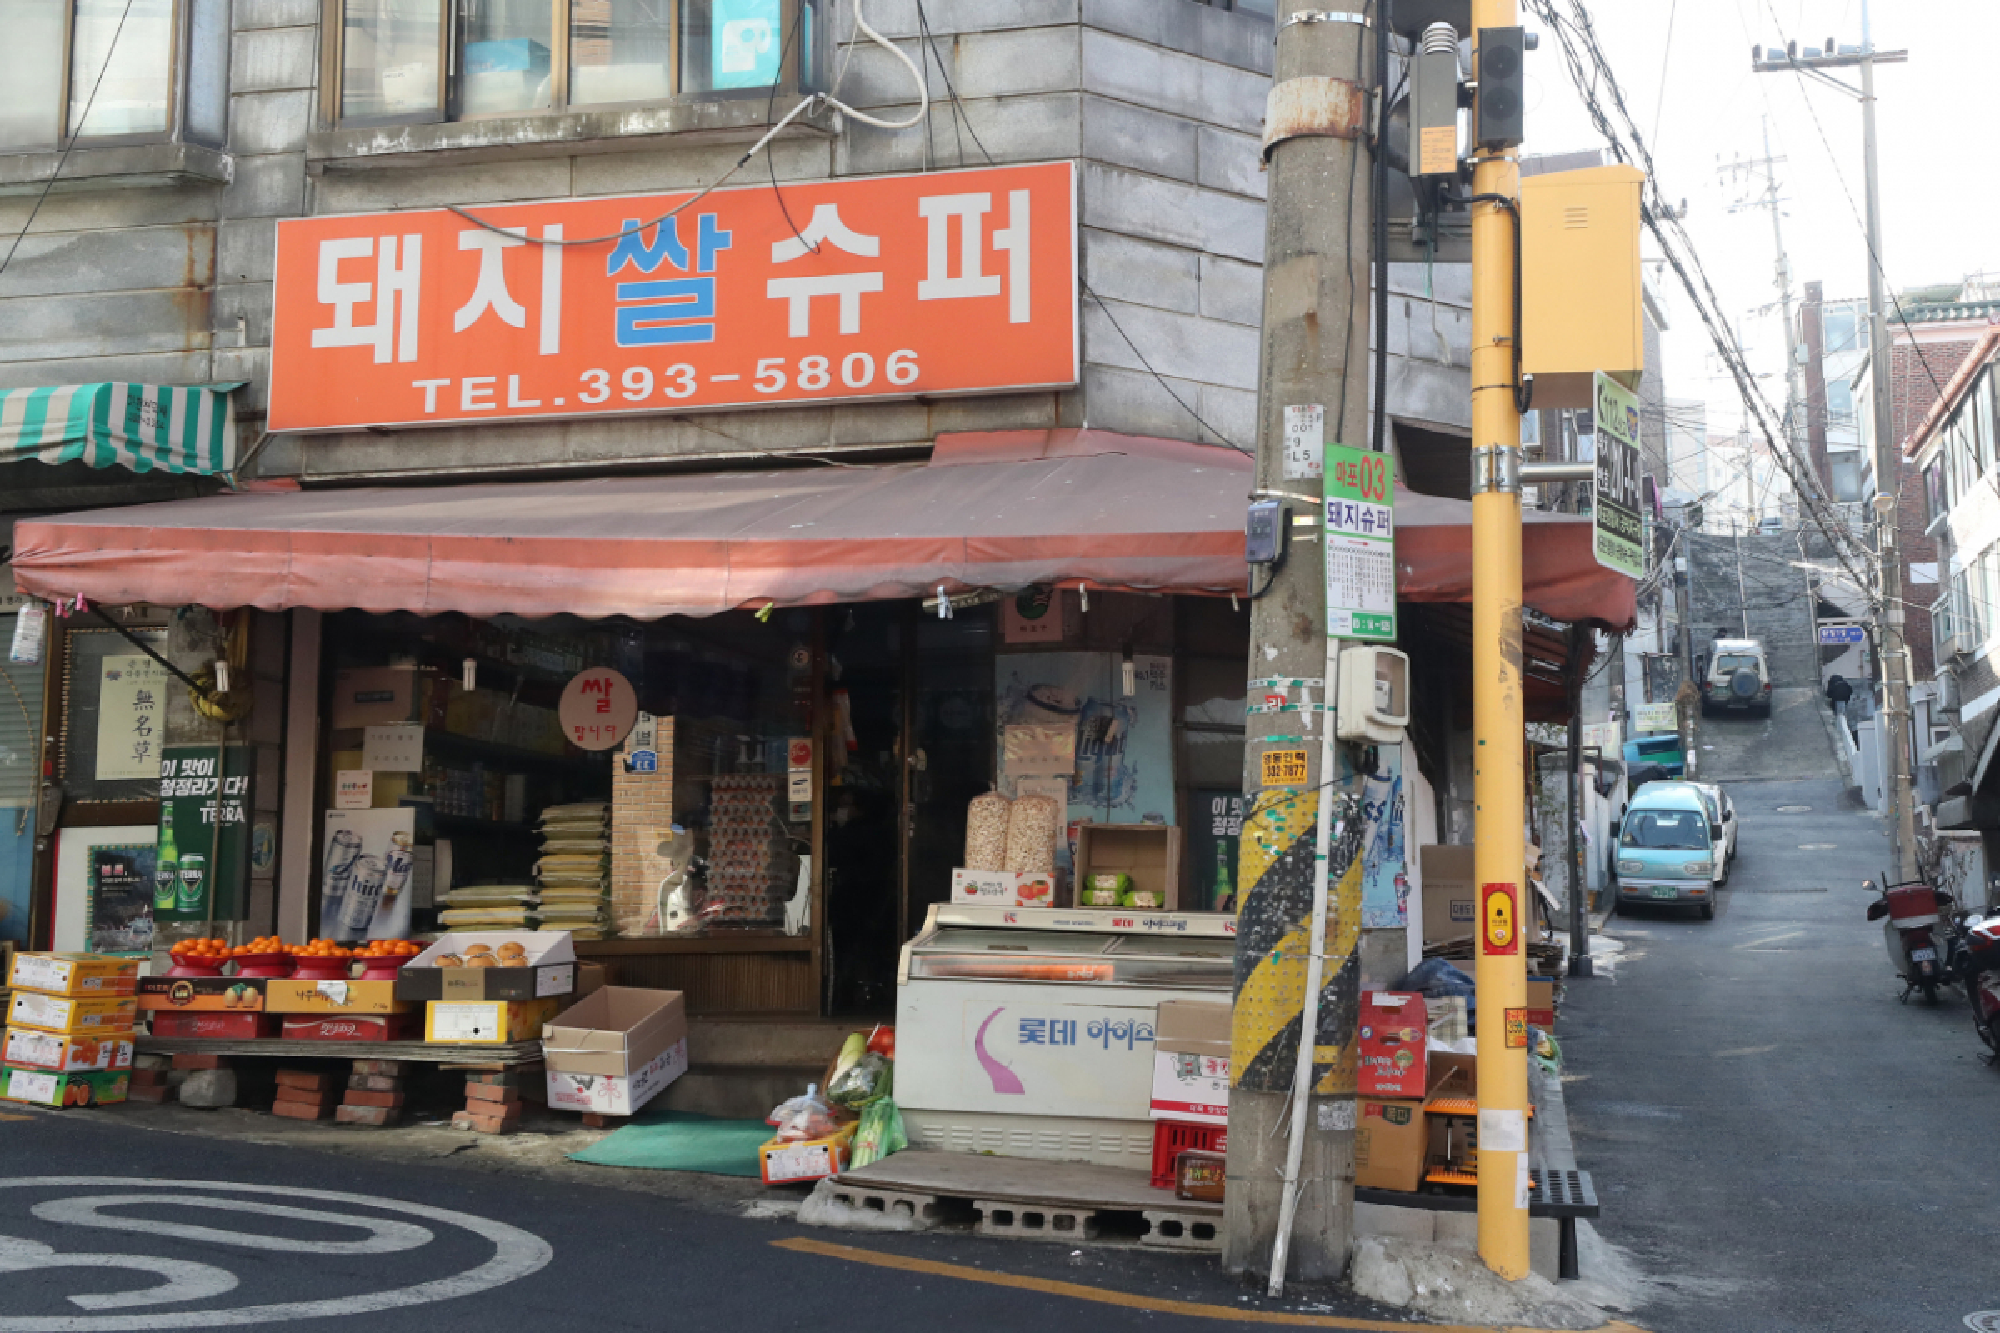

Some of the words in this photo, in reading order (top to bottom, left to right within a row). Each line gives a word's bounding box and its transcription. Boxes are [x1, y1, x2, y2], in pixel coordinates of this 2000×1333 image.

[311, 189, 1031, 364] 돼지쌀슈퍼
[412, 349, 920, 413] TEL.393-5806
[1327, 501, 1391, 535] 돼지슈퍼
[581, 678, 613, 713] 쌀
[162, 758, 178, 777] 이
[180, 758, 215, 776] 맛이
[1018, 1018, 1077, 1046] 롯데
